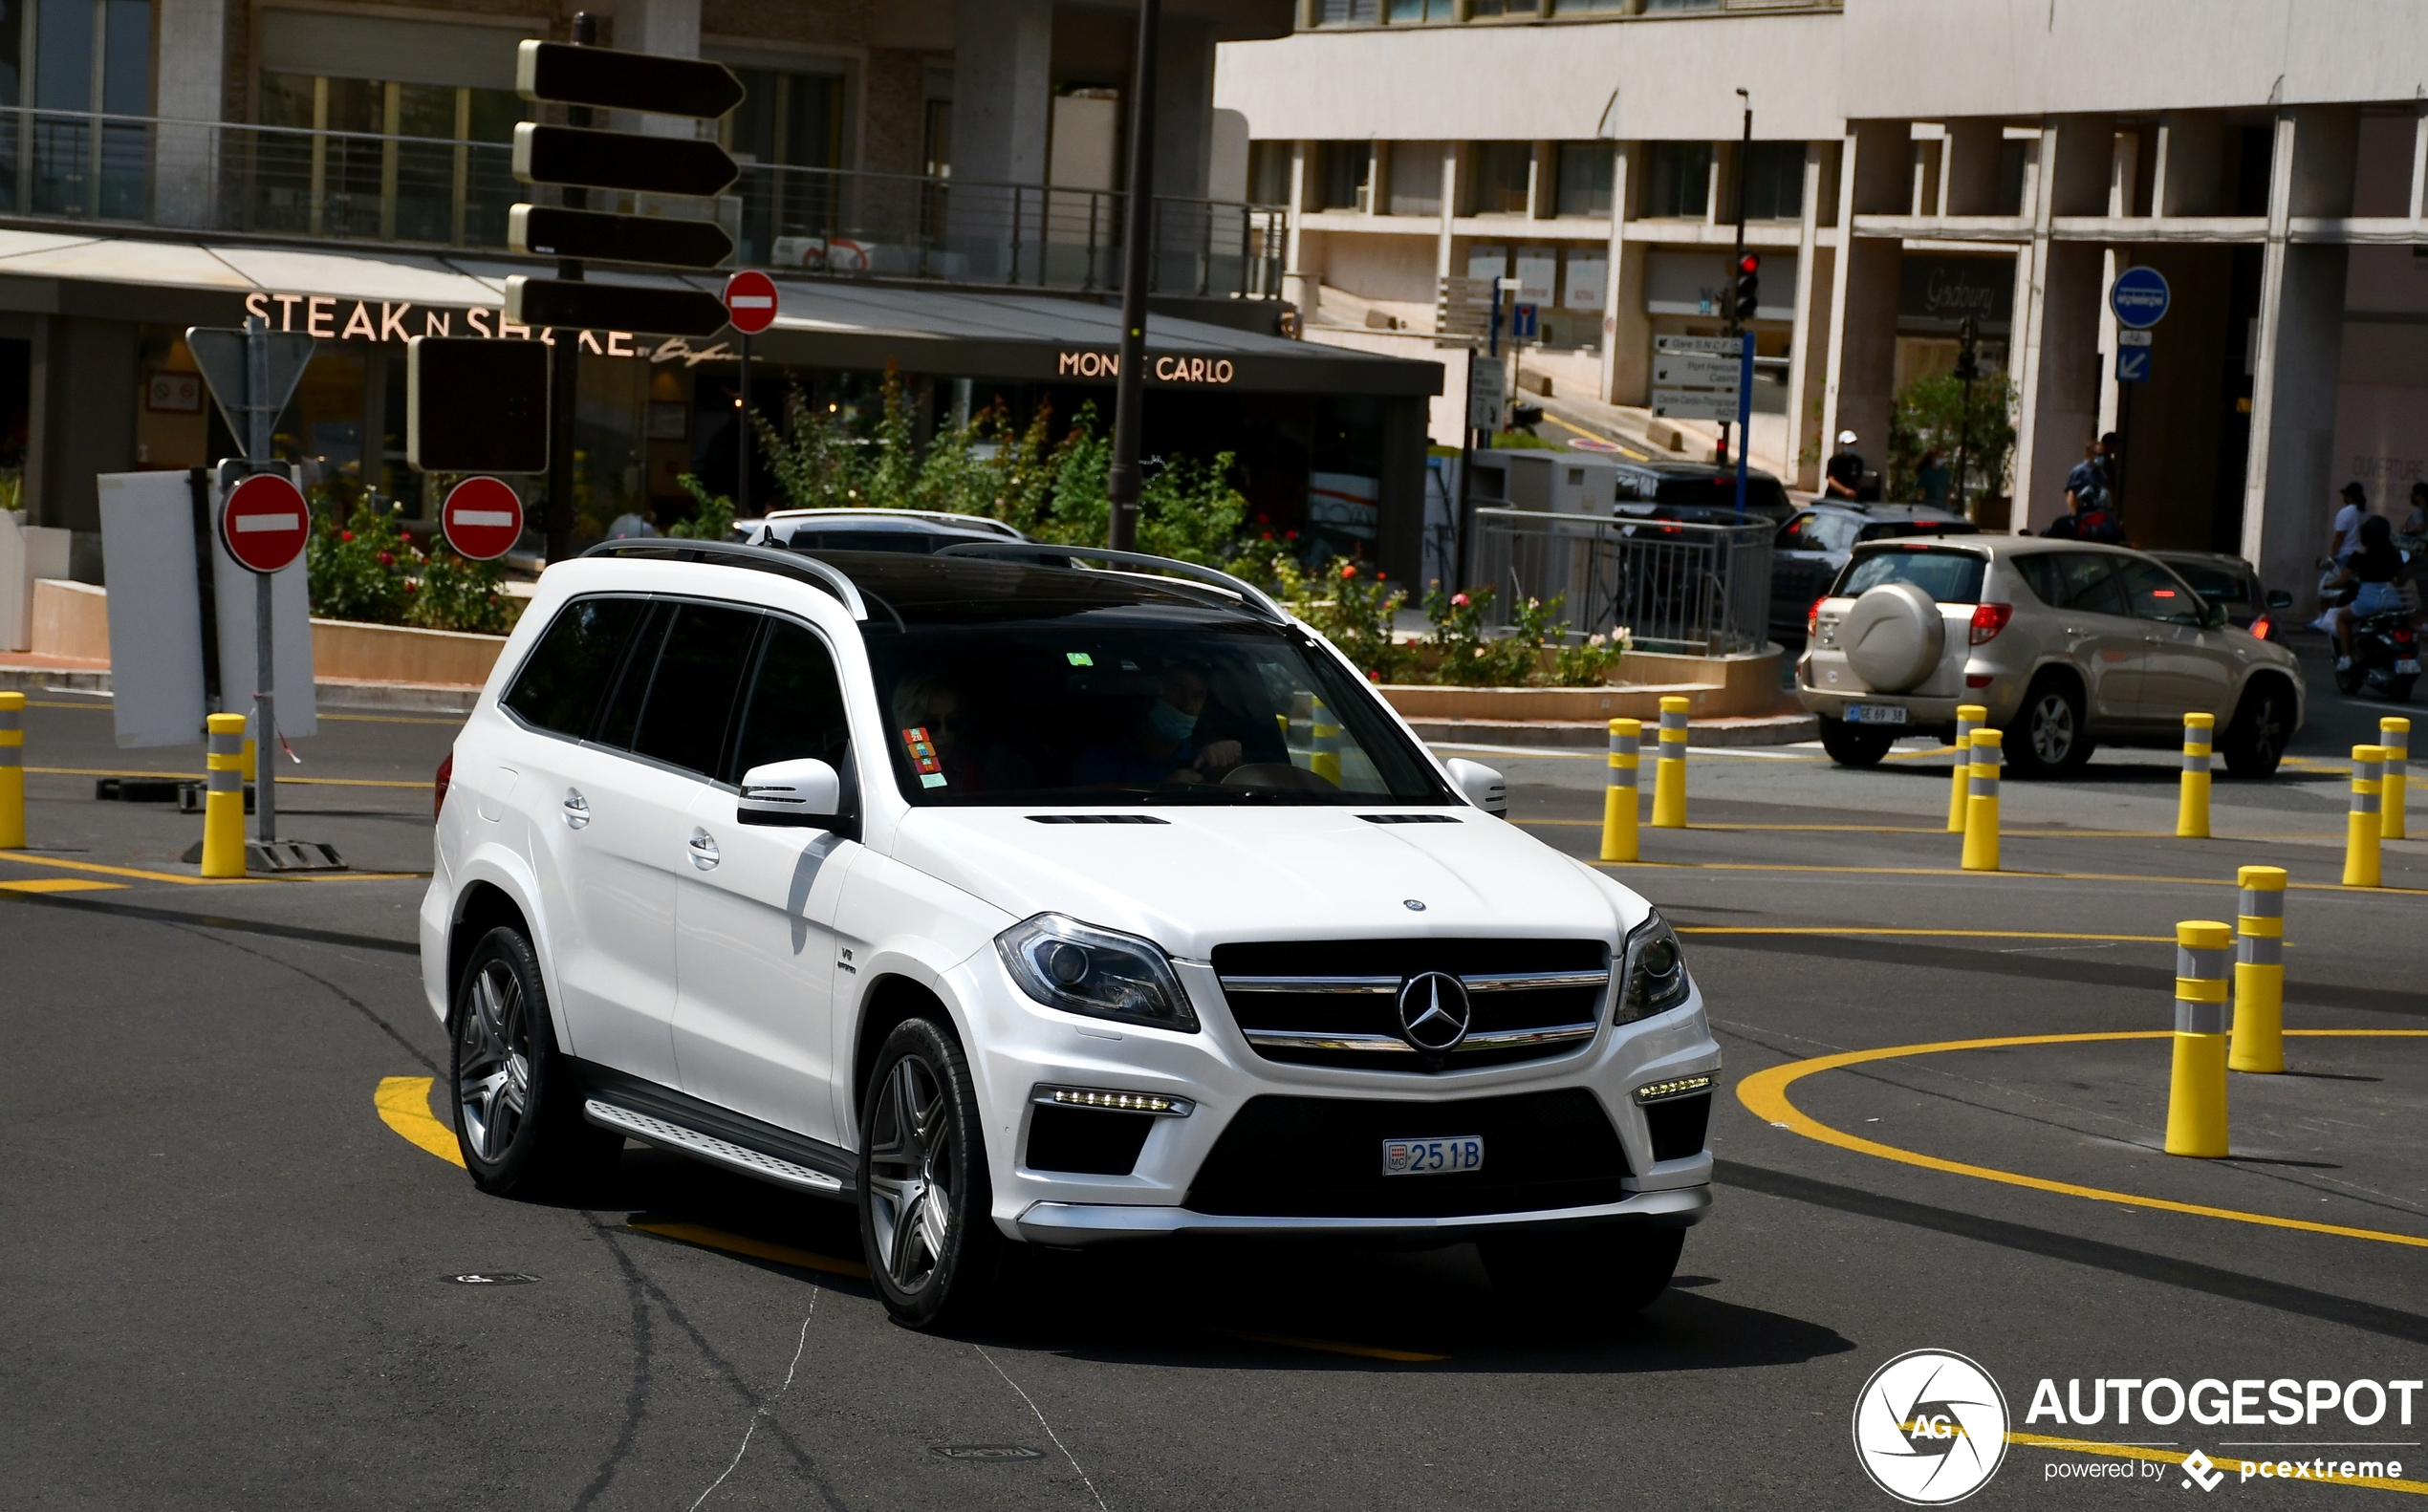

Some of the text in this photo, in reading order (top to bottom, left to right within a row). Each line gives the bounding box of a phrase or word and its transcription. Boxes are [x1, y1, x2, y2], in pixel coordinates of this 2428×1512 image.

[243, 292, 412, 343] STEAK
[426, 311, 450, 337] N
[1059, 352, 1234, 383] MON CARLO
[1391, 1141, 1480, 1171] MC 251B
